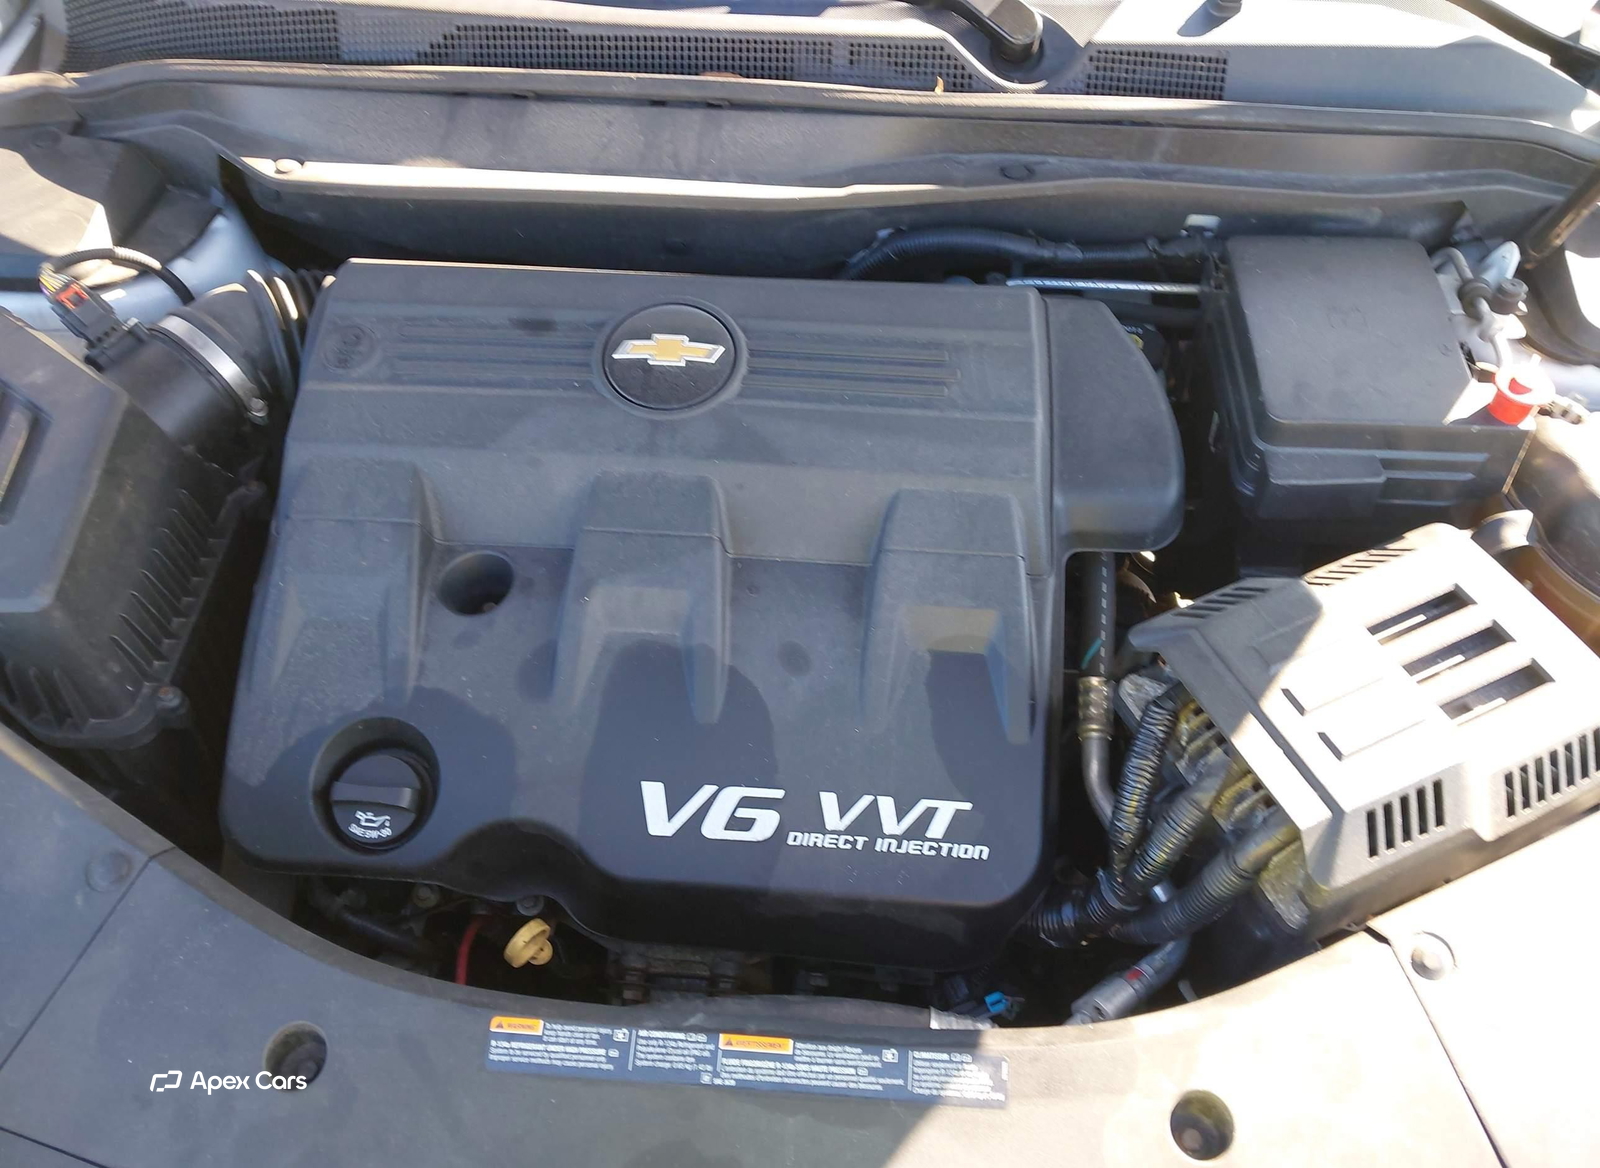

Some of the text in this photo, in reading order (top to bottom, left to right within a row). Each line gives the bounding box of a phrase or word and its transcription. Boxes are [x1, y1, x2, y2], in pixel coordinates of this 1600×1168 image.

[640, 780, 974, 842] V6 VVT
[786, 831, 990, 861] DIRECT INJECTION
